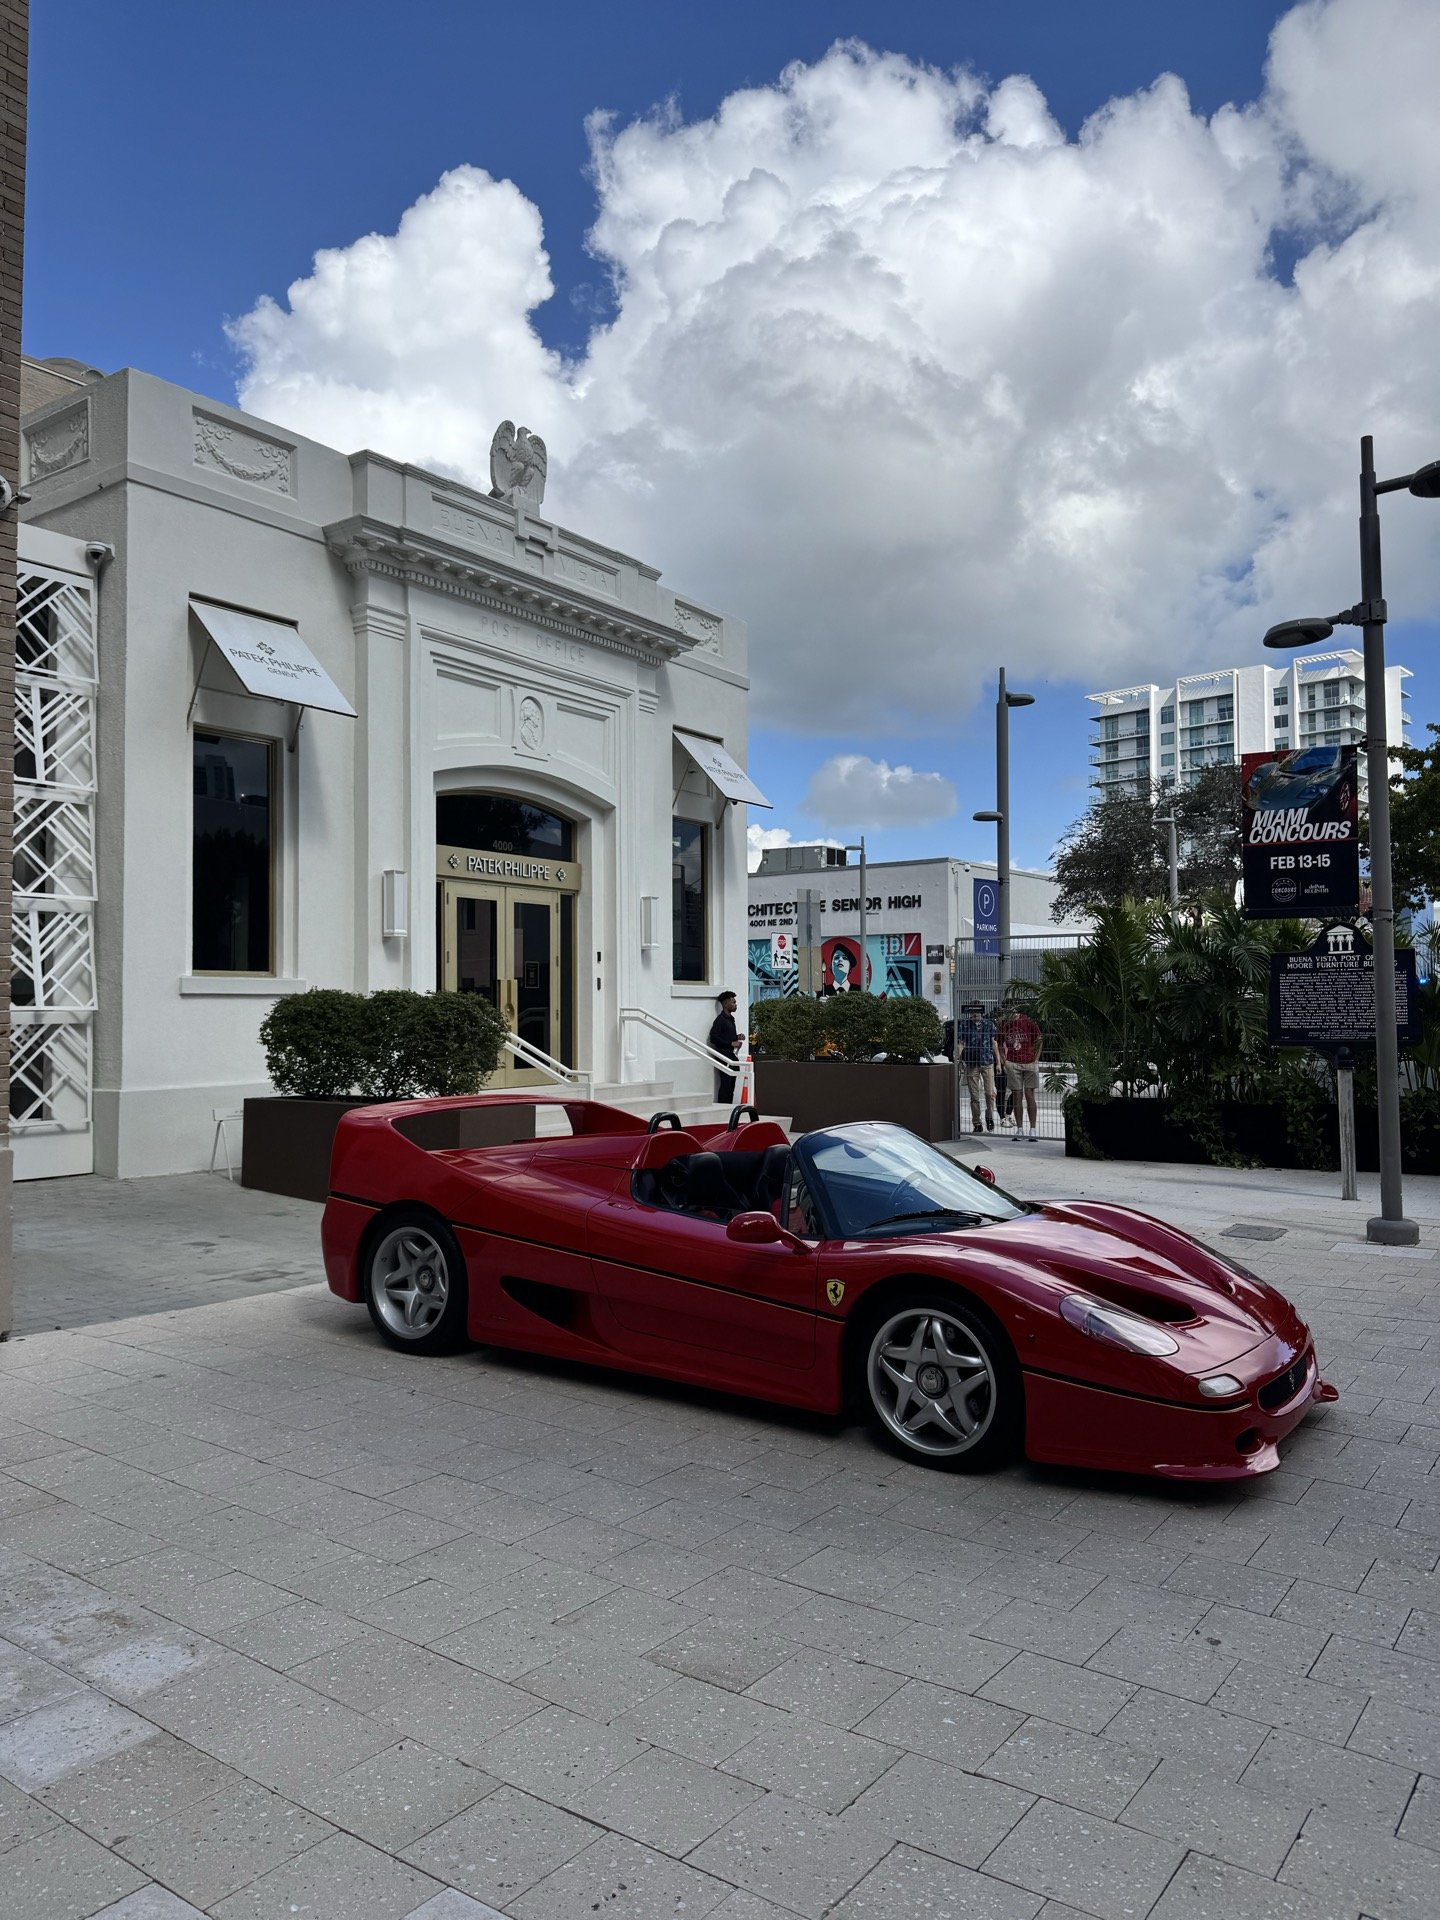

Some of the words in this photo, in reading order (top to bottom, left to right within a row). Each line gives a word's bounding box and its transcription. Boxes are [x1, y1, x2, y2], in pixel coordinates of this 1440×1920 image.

[439, 509, 505, 547] BUENA
[559, 556, 608, 590] VISTA
[481, 616, 520, 644] POST
[535, 633, 585, 664] OFFICE
[229, 648, 270, 666] PATEK
[268, 657, 321, 677] PHILIPPE
[1251, 807, 1309, 828] MIAMI
[1249, 821, 1352, 844] CONCOURS
[492, 839, 513, 852] 4000
[467, 855, 503, 875] PATEK
[504, 860, 550, 880] PHILIPPE
[1270, 856, 1295, 870] FEB
[1298, 854, 1331, 869] 13-15
[888, 894, 922, 909] HIGH
[983, 893, 990, 909] P
[749, 919, 766, 927] 4001
[767, 918, 777, 926] NE
[779, 918, 794, 926] 2ND
[976, 923, 997, 932] PARKING
[1316, 961, 1359, 969] FURNITURE
